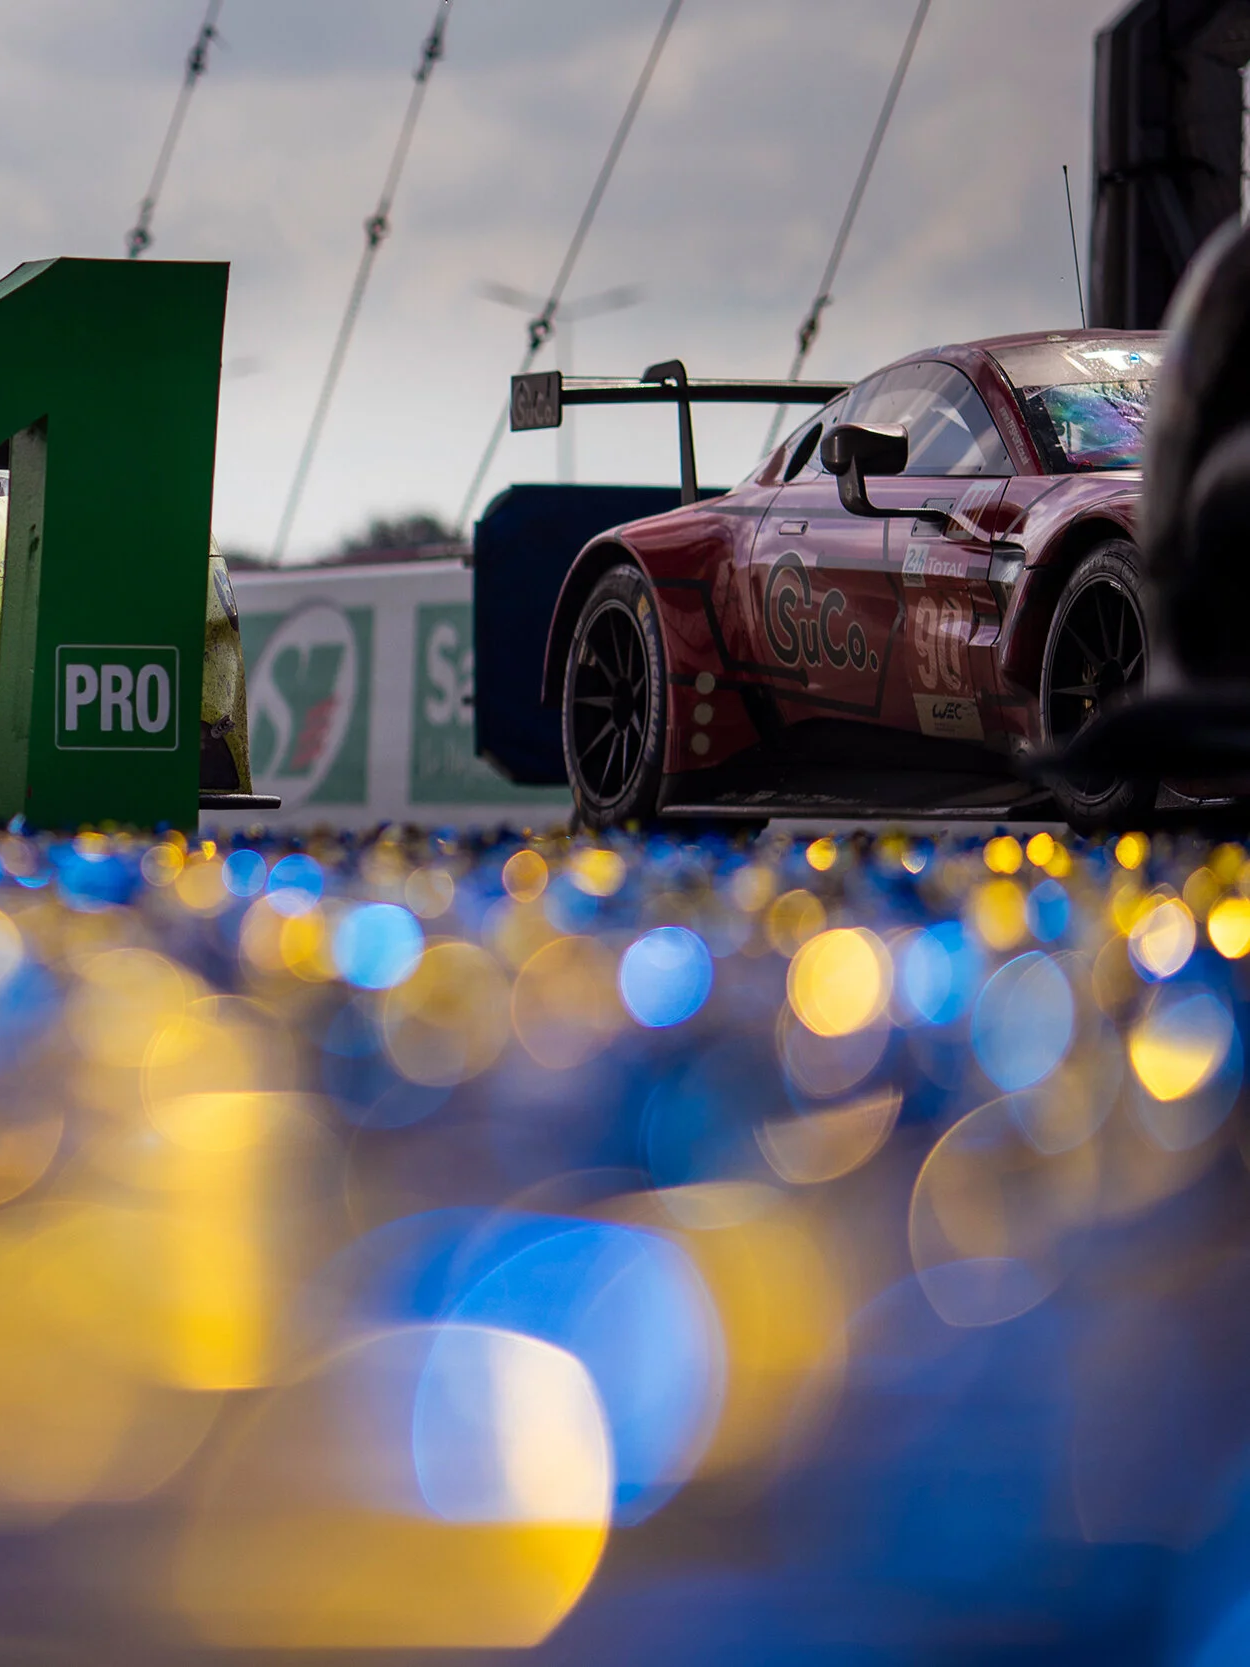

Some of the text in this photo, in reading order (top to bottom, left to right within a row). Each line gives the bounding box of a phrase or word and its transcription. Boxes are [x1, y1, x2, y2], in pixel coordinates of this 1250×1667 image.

[914, 596, 963, 691] 90
[65, 663, 170, 733] PRO
[932, 702, 963, 720] WEC
